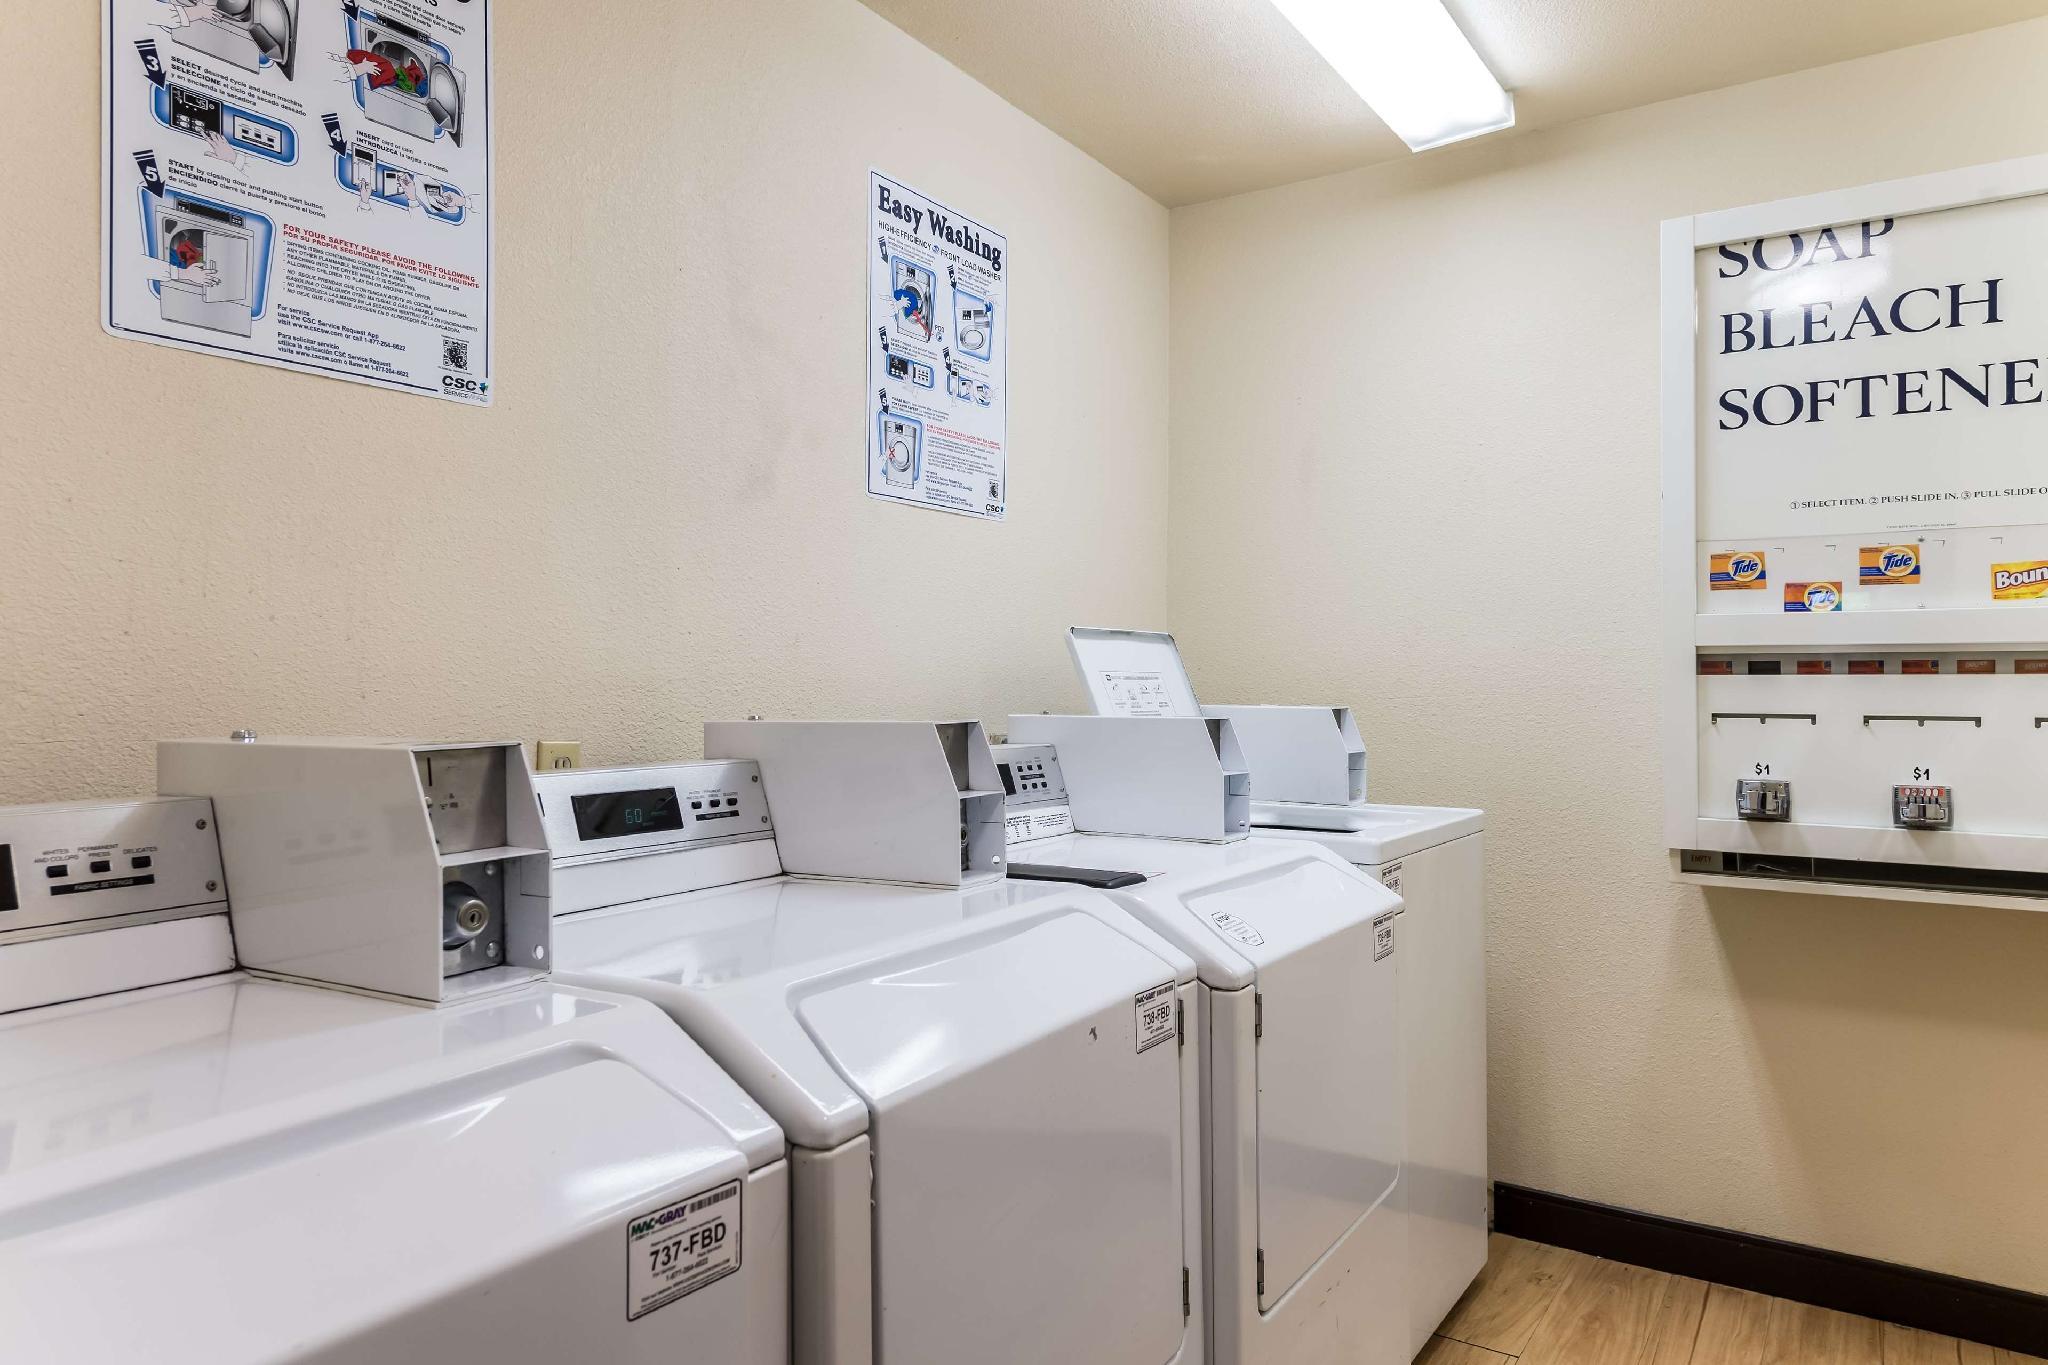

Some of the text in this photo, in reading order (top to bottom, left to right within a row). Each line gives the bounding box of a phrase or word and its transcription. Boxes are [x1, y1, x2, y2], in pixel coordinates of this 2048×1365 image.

[147, 56, 159, 71] 3
[171, 55, 201, 71] SELECT
[229, 77, 246, 88] cycle
[248, 84, 260, 92] and
[261, 88, 275, 98] start
[171, 63, 220, 86] SELECCIONE
[230, 85, 245, 95] ciclo
[330, 130, 340, 141] 4
[356, 129, 380, 142] INSERT
[356, 136, 398, 155] INTRODUZCA
[144, 166, 158, 181] 5
[168, 166, 217, 186] ENCIENDIDO
[219, 182, 237, 192] cierre
[247, 190, 267, 201] puerta
[168, 158, 193, 171] START
[196, 167, 203, 175] by
[206, 170, 230, 183] closing
[232, 178, 246, 187] door
[262, 187, 286, 200] pushing
[288, 196, 302, 204] start
[304, 200, 323, 210] button
[878, 183, 923, 237] Easy
[927, 206, 1001, 273] Washing
[283, 223, 474, 282] FOR YOUR SAFETY PLEASE AVOID THE FOLLOWING
[283, 230, 299, 240] POR
[312, 238, 337, 250] PROPIA
[381, 257, 394, 266] POR
[396, 262, 416, 272] FAVOR
[418, 267, 436, 277] EVITE
[1718, 217, 1894, 278] SOAP
[940, 247, 959, 264] FRONT
[977, 264, 1001, 283] WASHER
[277, 303, 309, 316] For service
[1720, 279, 2003, 355] BLEACH
[277, 318, 290, 326] visit
[302, 316, 315, 324] CSC
[317, 319, 340, 330] Service
[341, 325, 365, 336] Request
[367, 331, 378, 339] App
[277, 331, 291, 339] Para
[317, 340, 339, 350] servicio
[334, 350, 346, 358] CSC
[347, 353, 368, 362] Service
[369, 357, 390, 367] Request
[441, 374, 476, 392] CSC
[1718, 358, 2048, 431] SOFTENE
[1802, 499, 1837, 508] SELECT
[1881, 495, 1909, 503] PUSH
[1911, 493, 1941, 501] SLIDE
[2003, 488, 2037, 496] SLIDE
[986, 504, 999, 513] CSC
[1732, 560, 1758, 576] Tide
[1883, 554, 1913, 571] Tide
[1755, 762, 1770, 775] $1
[1913, 767, 1930, 781] $1
[625, 807, 641, 824] 60
[77, 844, 118, 852] PERMANENT
[122, 846, 157, 854] DELICATES
[1143, 1005, 1170, 1026] 738-FBD
[631, 1204, 688, 1237] MAC-GRAY
[650, 1222, 727, 1271] 737-FBD
